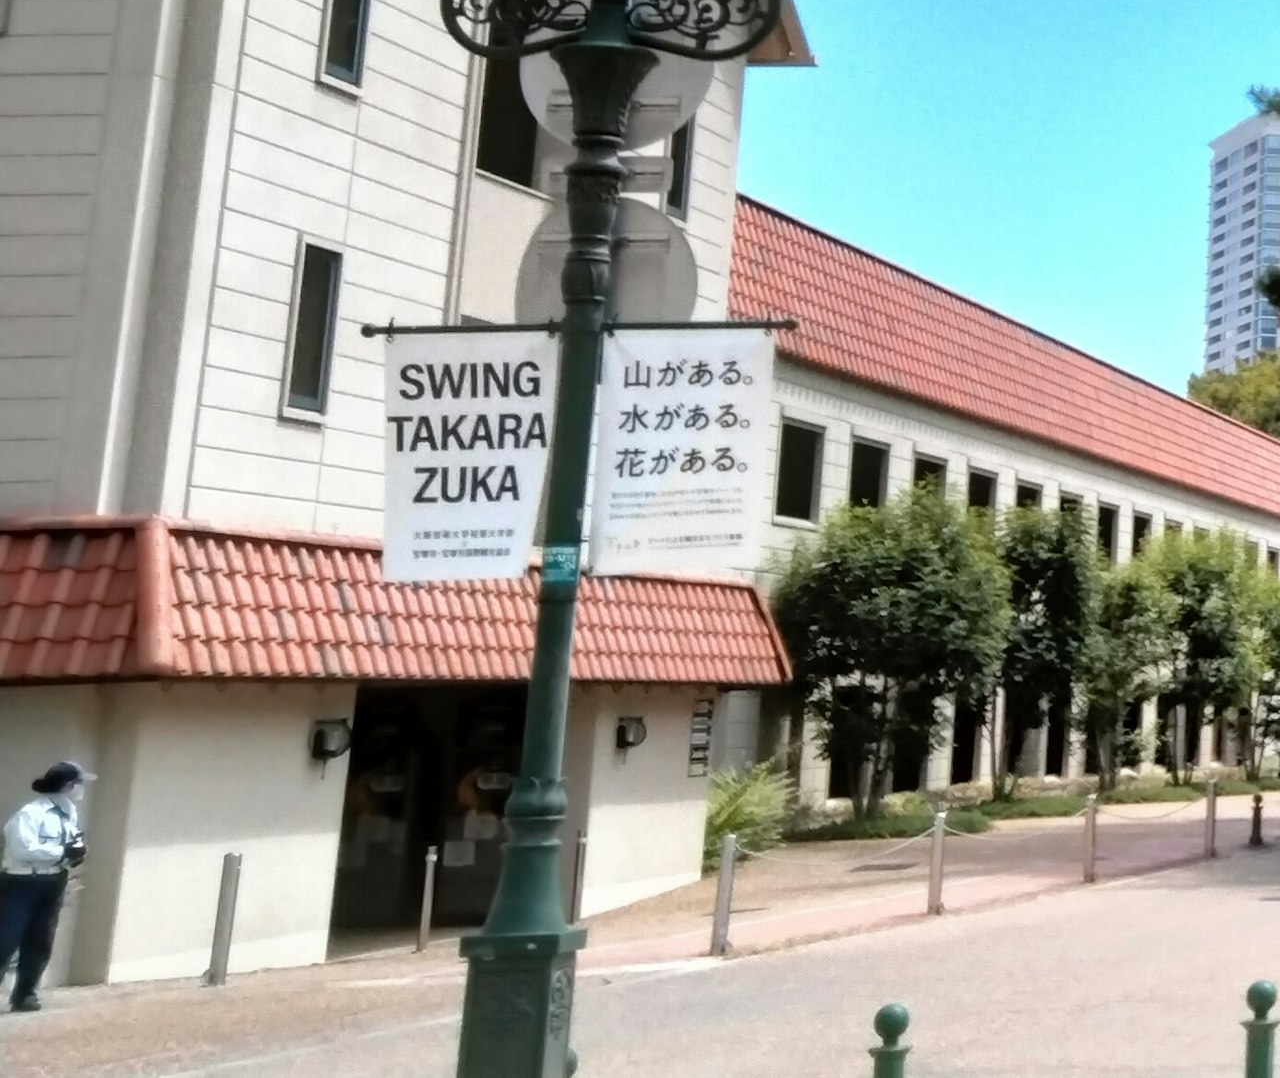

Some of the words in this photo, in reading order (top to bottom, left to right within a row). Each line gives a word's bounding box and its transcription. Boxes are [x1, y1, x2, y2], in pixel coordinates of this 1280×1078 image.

[399, 360, 541, 400] SWING
[623, 358, 754, 389] 山がある。
[387, 413, 547, 452] TAKARA
[618, 402, 752, 434] 水がある。
[614, 446, 748, 479] 花がある。
[412, 465, 520, 504] ZUKA
